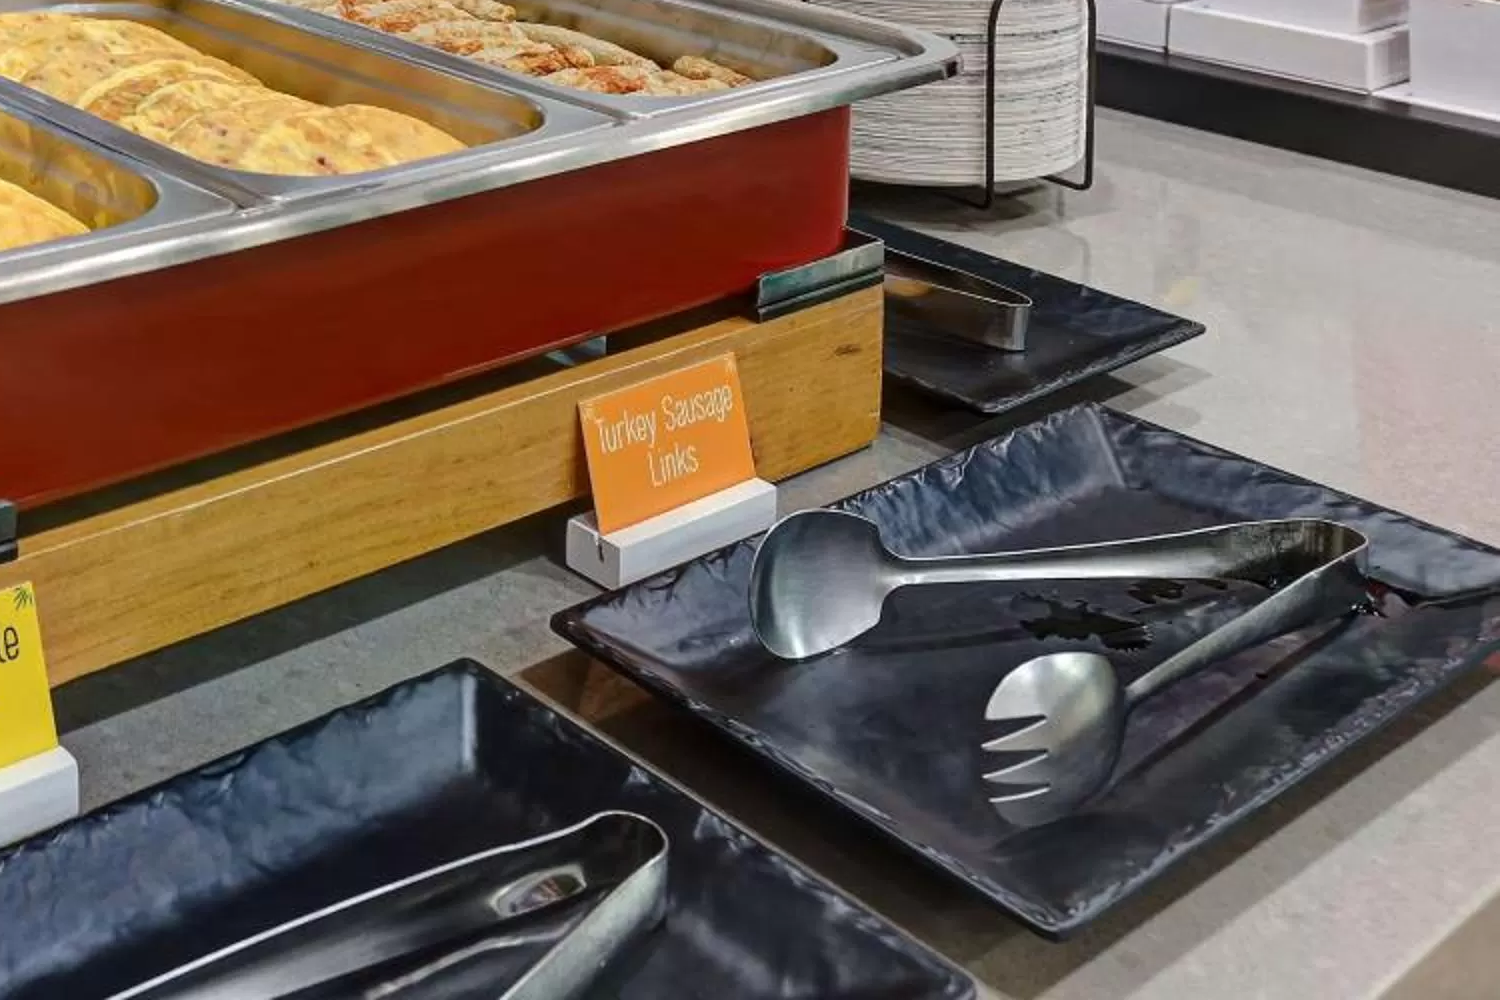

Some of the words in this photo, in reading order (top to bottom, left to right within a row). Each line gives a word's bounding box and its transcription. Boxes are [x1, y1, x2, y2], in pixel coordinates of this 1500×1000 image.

[595, 406, 657, 454] Turkey
[660, 384, 733, 431] Sausage
[647, 443, 699, 488] Links
